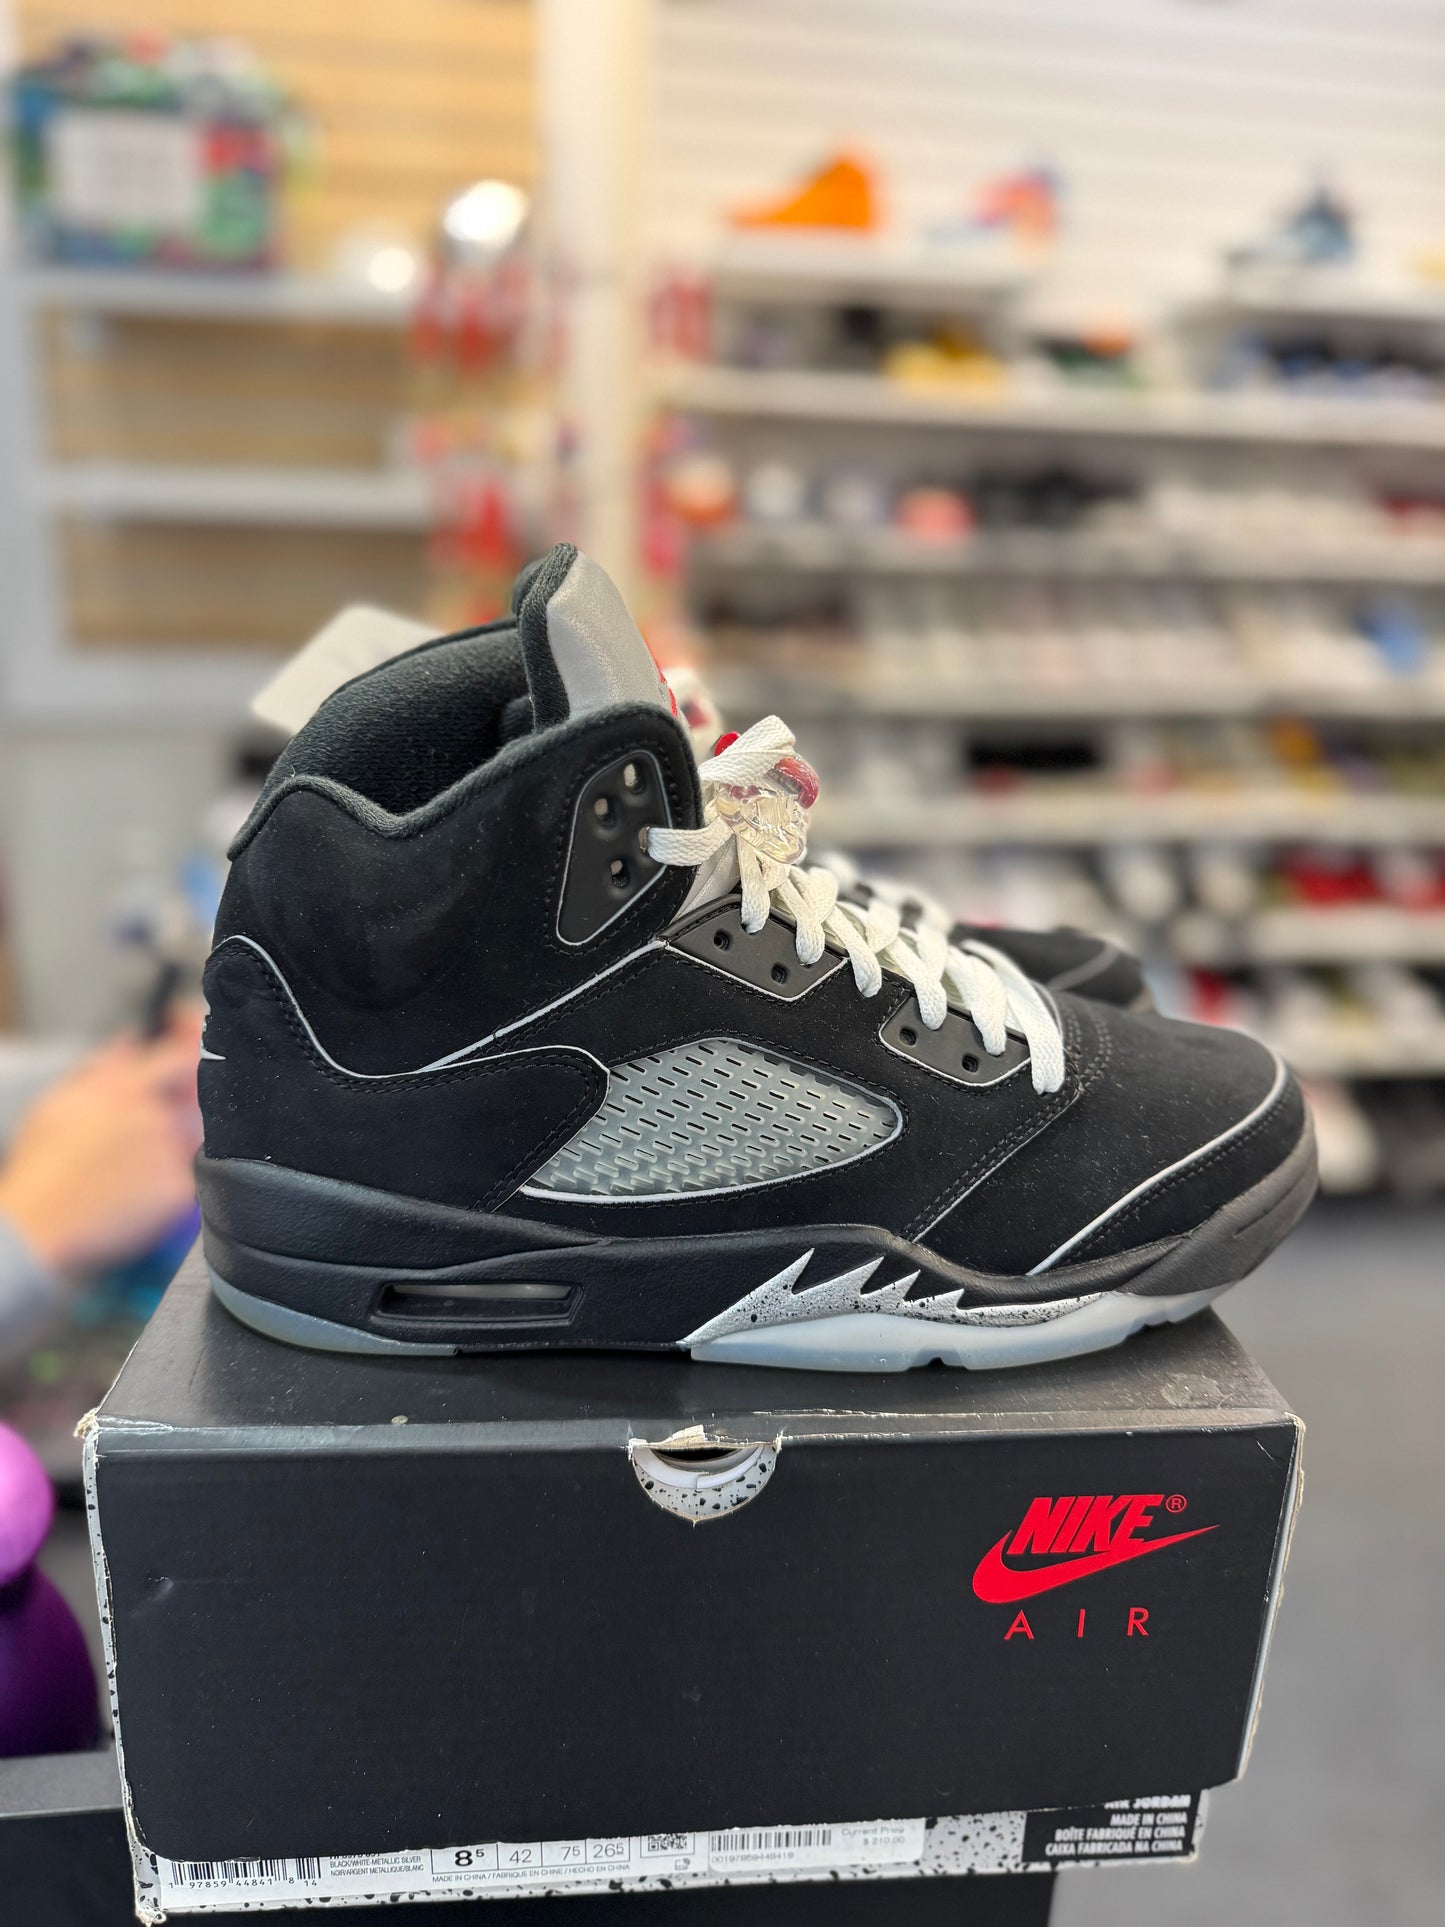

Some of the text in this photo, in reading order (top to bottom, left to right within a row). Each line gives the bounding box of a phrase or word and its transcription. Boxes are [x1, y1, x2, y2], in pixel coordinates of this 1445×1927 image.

[1003, 1607, 1149, 1640] AIR
[1132, 1794, 1191, 1810] JORDAN
[1110, 1811, 1188, 1827] MADE IN CHINA
[841, 1827, 878, 1837] Current
[1137, 1827, 1152, 1839] EN
[1153, 1825, 1186, 1839] CHINA
[1045, 1839, 1184, 1856] CAIXA FABRICADA NA CHINA
[401, 1855, 422, 1864] SILVER
[509, 1849, 532, 1864] 42
[432, 1874, 453, 1883] MADE
[455, 1873, 462, 1881] IN
[464, 1872, 486, 1881] CHINA
[529, 1869, 539, 1877] EN
[541, 1867, 563, 1876] CHINE
[568, 1866, 595, 1874] HECHO
[596, 1864, 606, 1873] EN
[607, 1863, 630, 1872] CHINA
[189, 1880, 227, 1889] 97859
[236, 1879, 273, 1887] 44841
